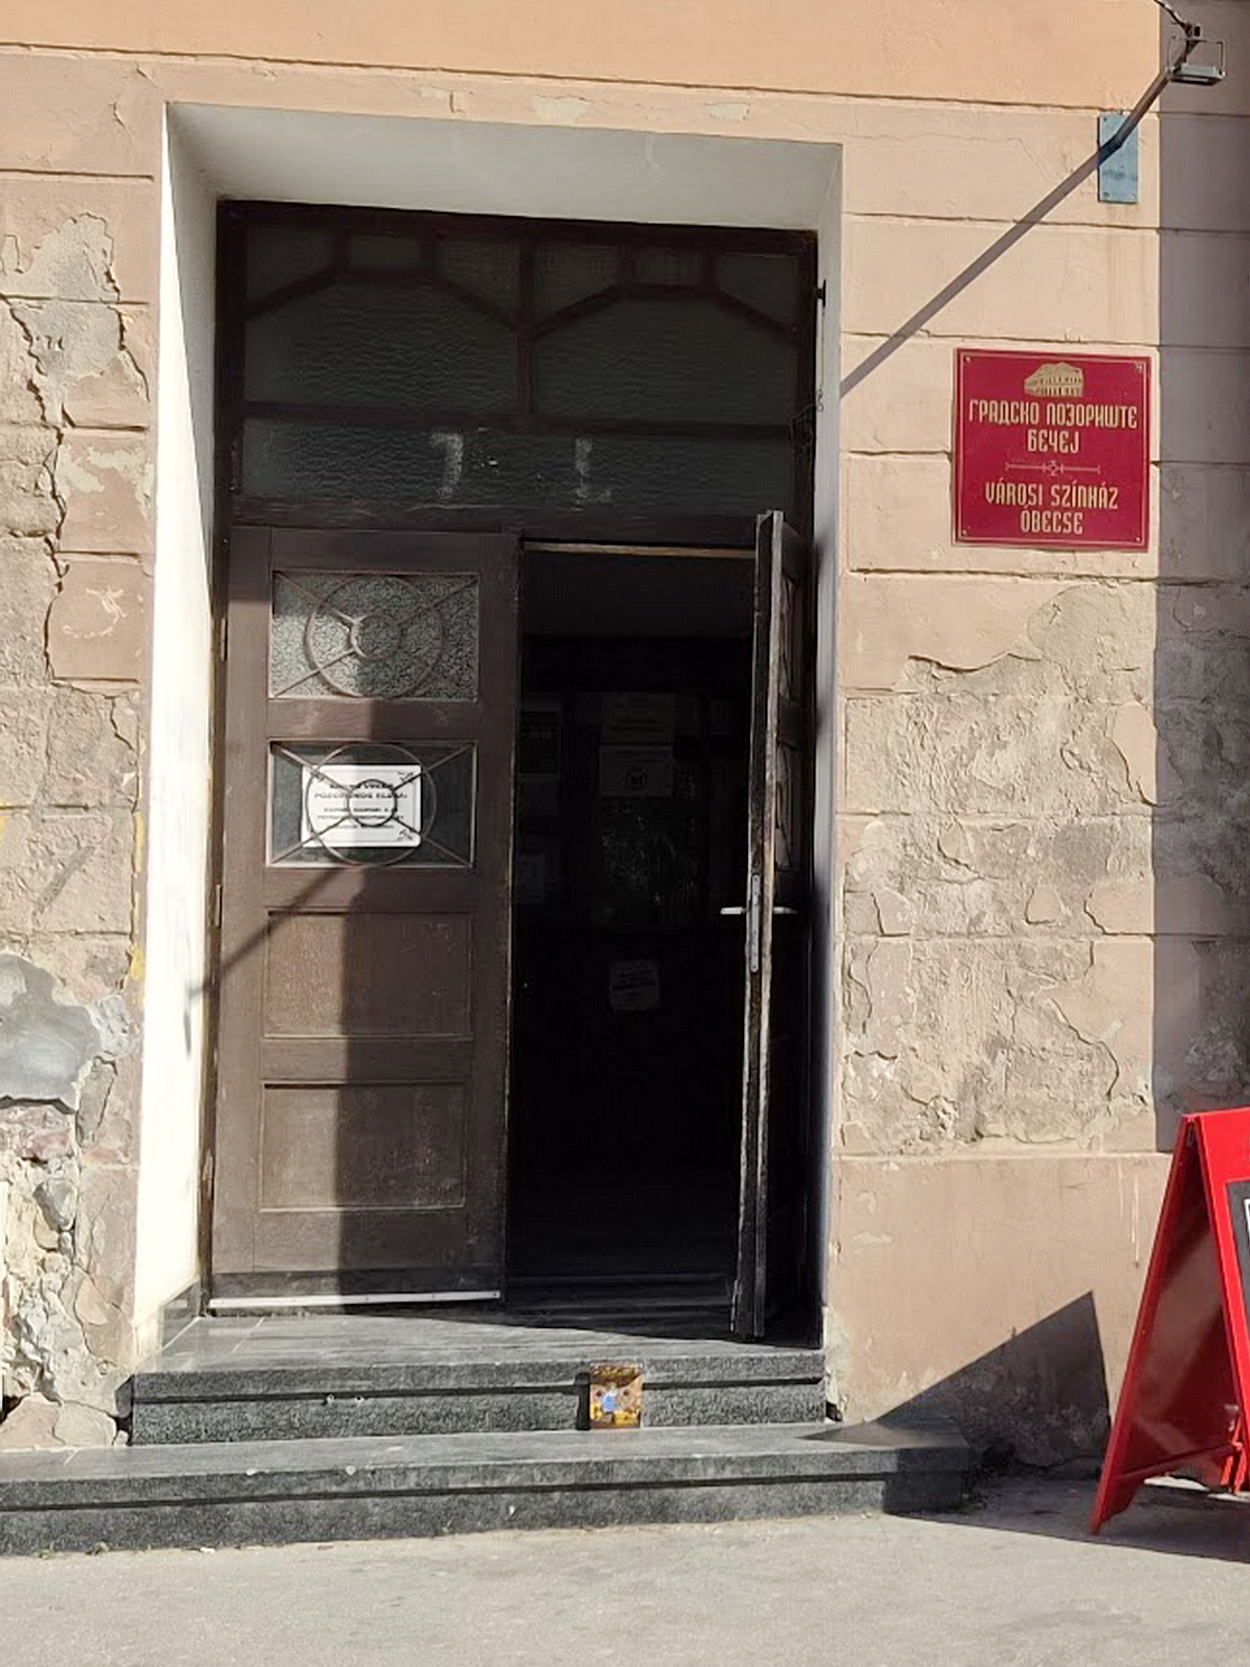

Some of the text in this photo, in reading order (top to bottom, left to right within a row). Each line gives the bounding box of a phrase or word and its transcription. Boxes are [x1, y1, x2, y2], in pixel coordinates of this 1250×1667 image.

[968, 399, 1138, 429] ГРАДСКО ПОЗОРИШТЕ
[1027, 429, 1080, 454] БЕЧЕЈ
[985, 477, 1119, 510] VÁROSI SZÍNHÁZ
[1020, 505, 1084, 535] ÓBECSE
